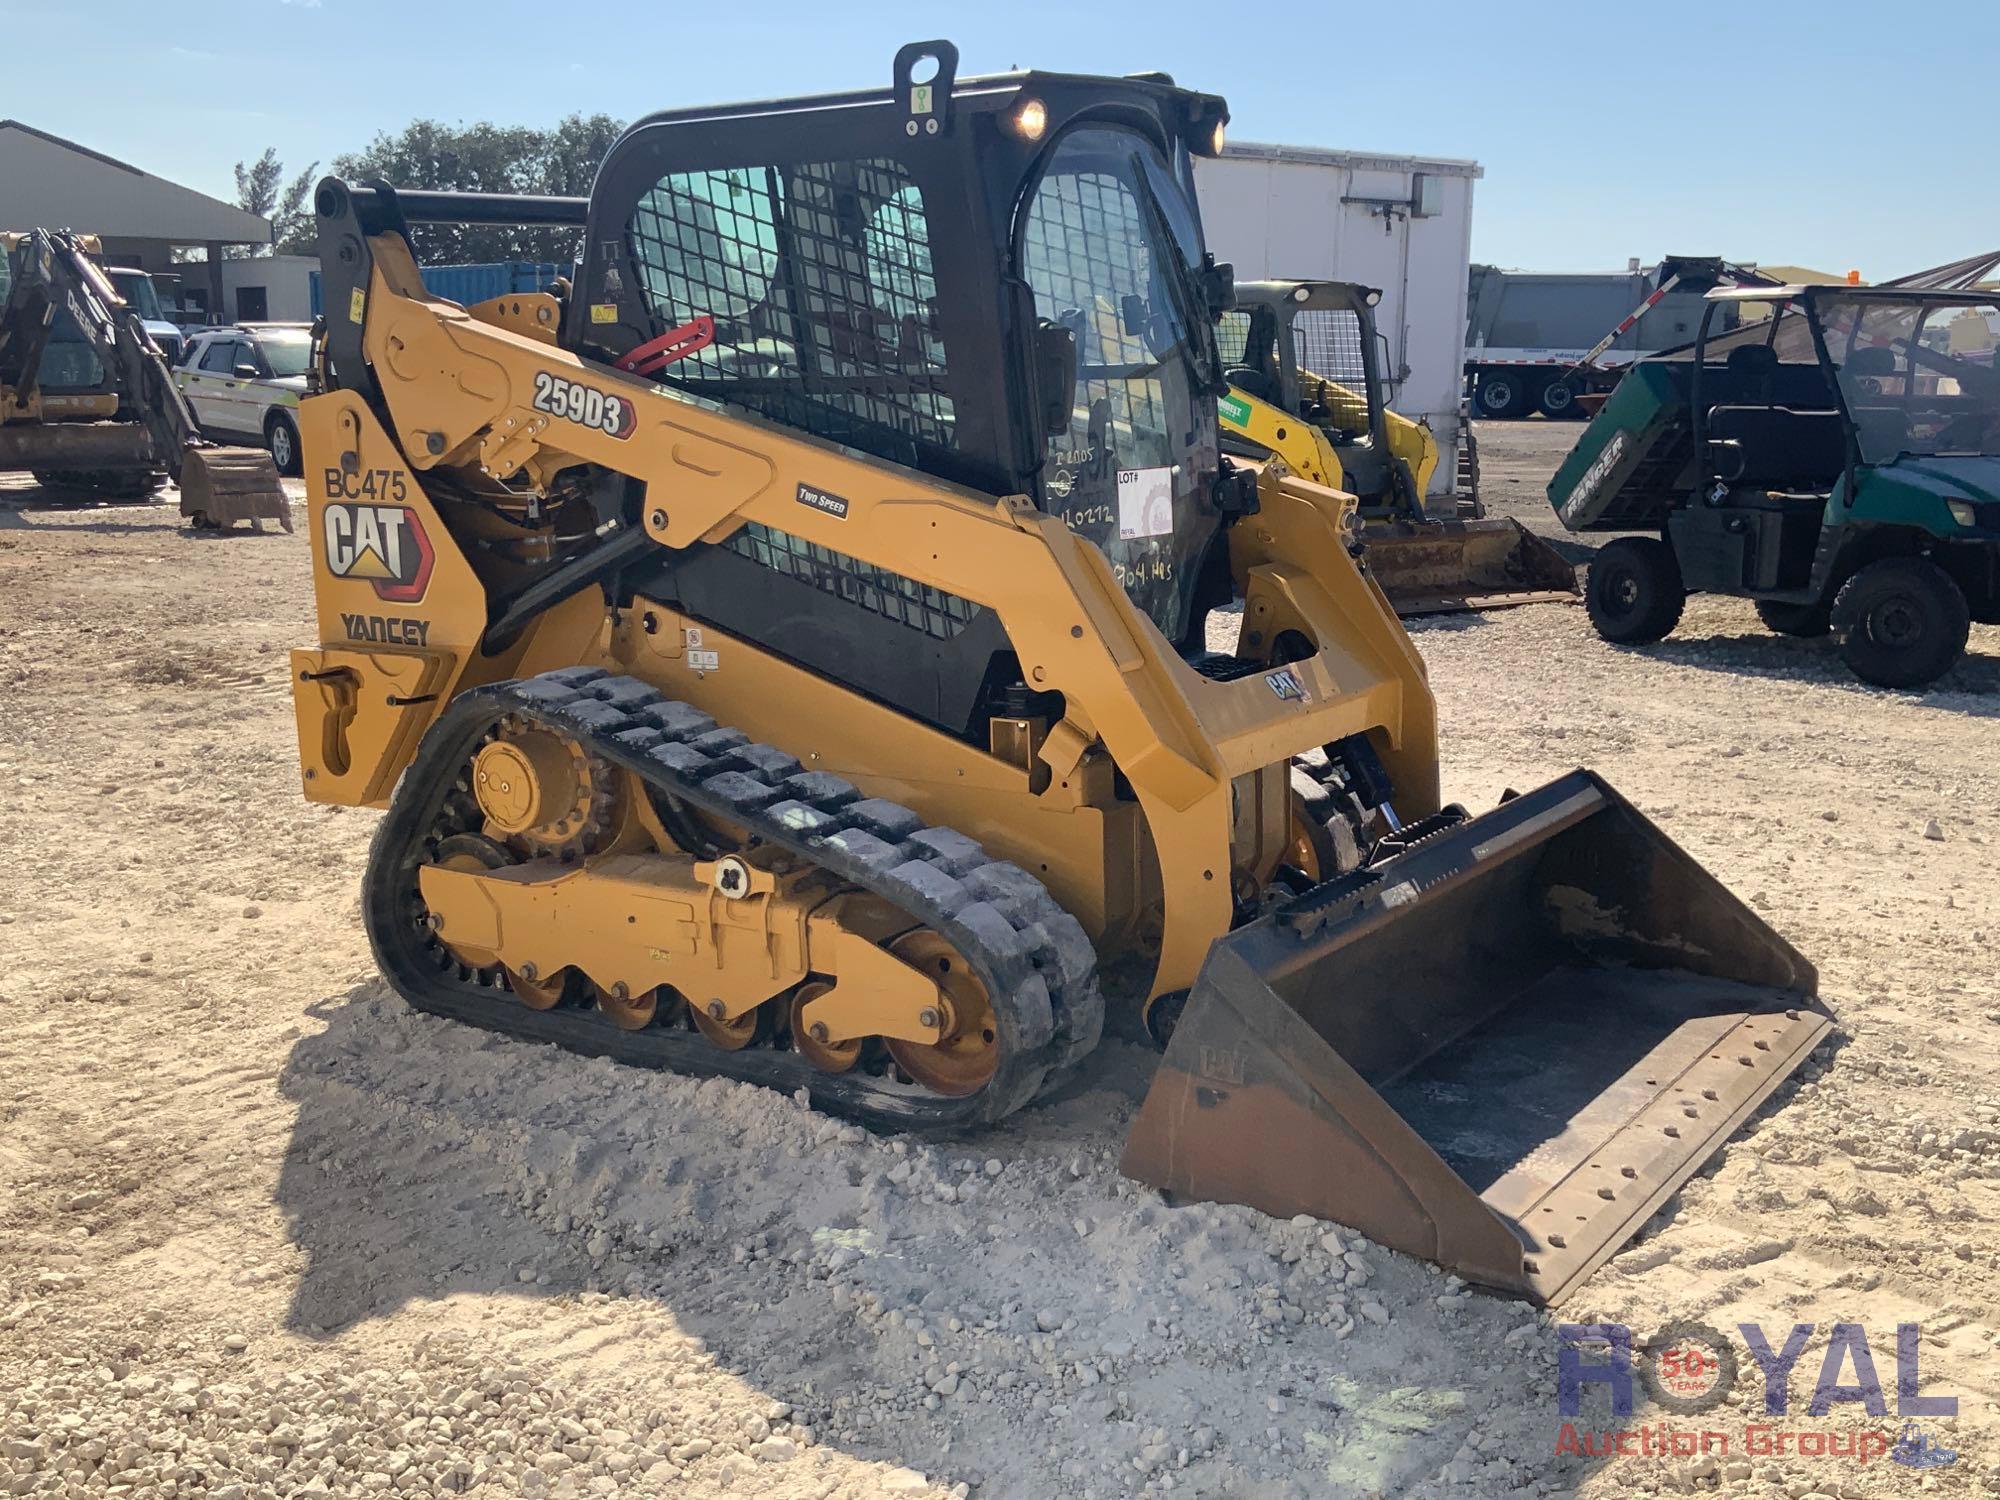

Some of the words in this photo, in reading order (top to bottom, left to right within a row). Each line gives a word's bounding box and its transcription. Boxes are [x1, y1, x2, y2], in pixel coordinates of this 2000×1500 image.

[68, 289, 97, 344] DEERE
[534, 373, 621, 434] 259D3
[325, 468, 407, 501] BC475
[1119, 472, 1138, 484] LOT#
[1567, 436, 1623, 518] RANGER
[325, 505, 405, 579] CAT
[340, 613, 431, 647] YANCEY
[1265, 671, 1302, 699] CAT
